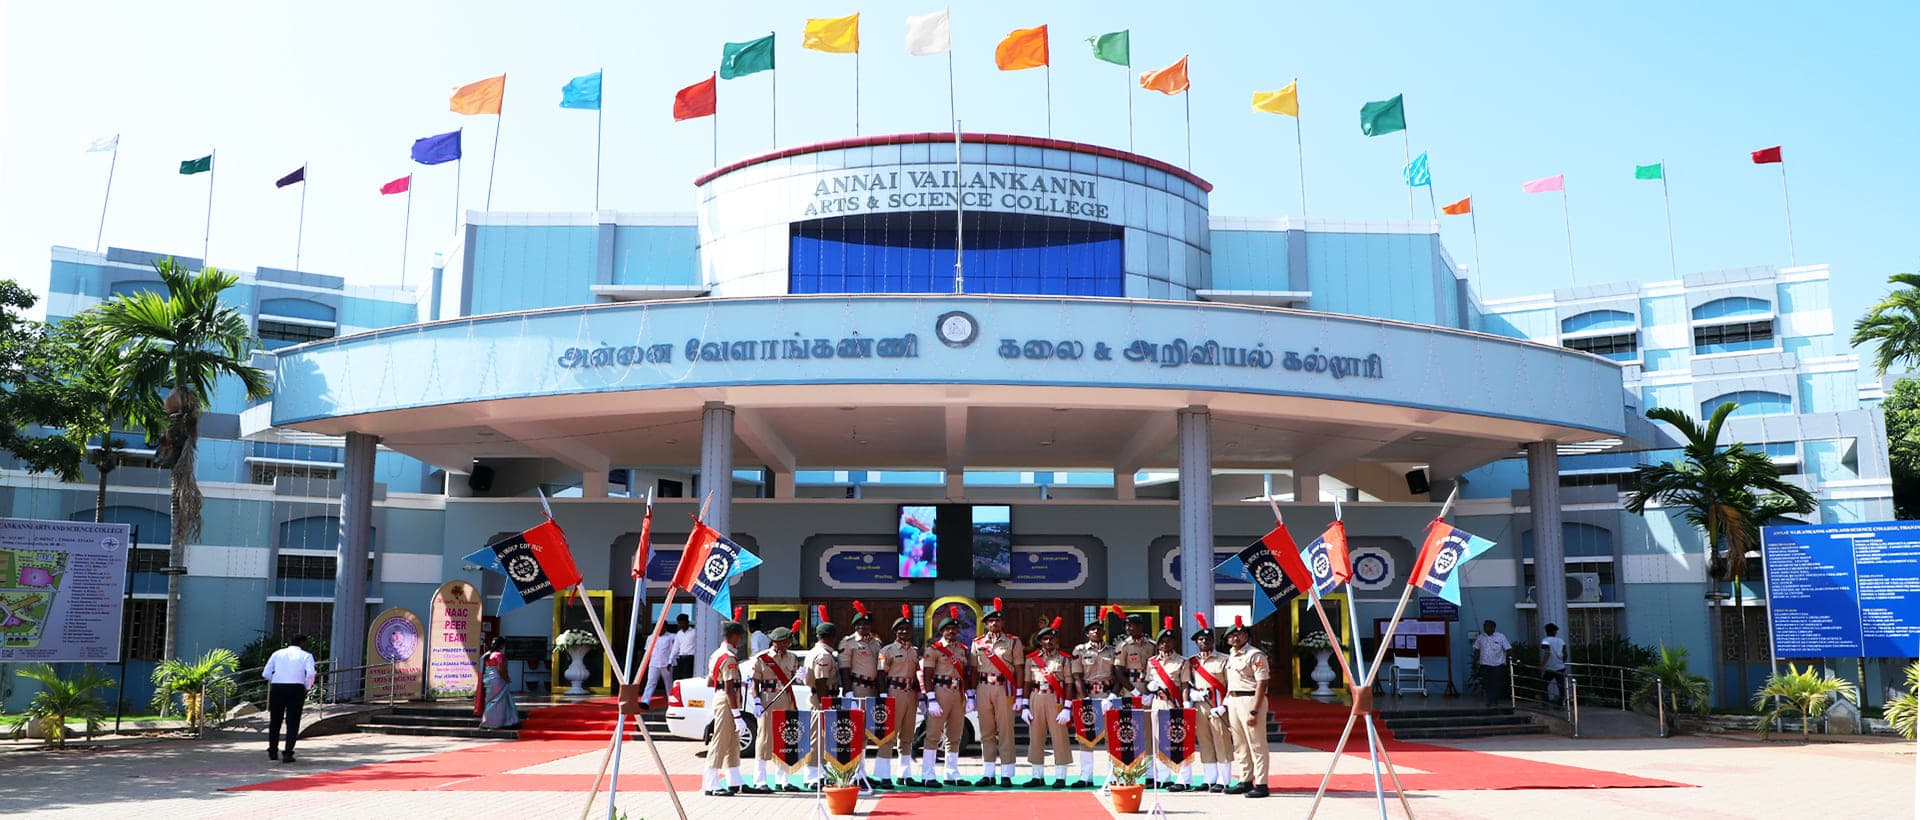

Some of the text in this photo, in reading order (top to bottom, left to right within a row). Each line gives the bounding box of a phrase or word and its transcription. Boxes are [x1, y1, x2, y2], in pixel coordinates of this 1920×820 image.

[813, 171, 1095, 199] ANNAI VAILANKANNI
[804, 191, 1110, 219] ARTS & SCIENCE COLLEGE
[998, 338, 1084, 361] கலை
[1093, 341, 1112, 361] &
[1122, 337, 1273, 369] அறிவியல்
[445, 607, 468, 617] NAAC
[445, 620, 467, 630] PEER
[443, 633, 467, 642] TEAM
